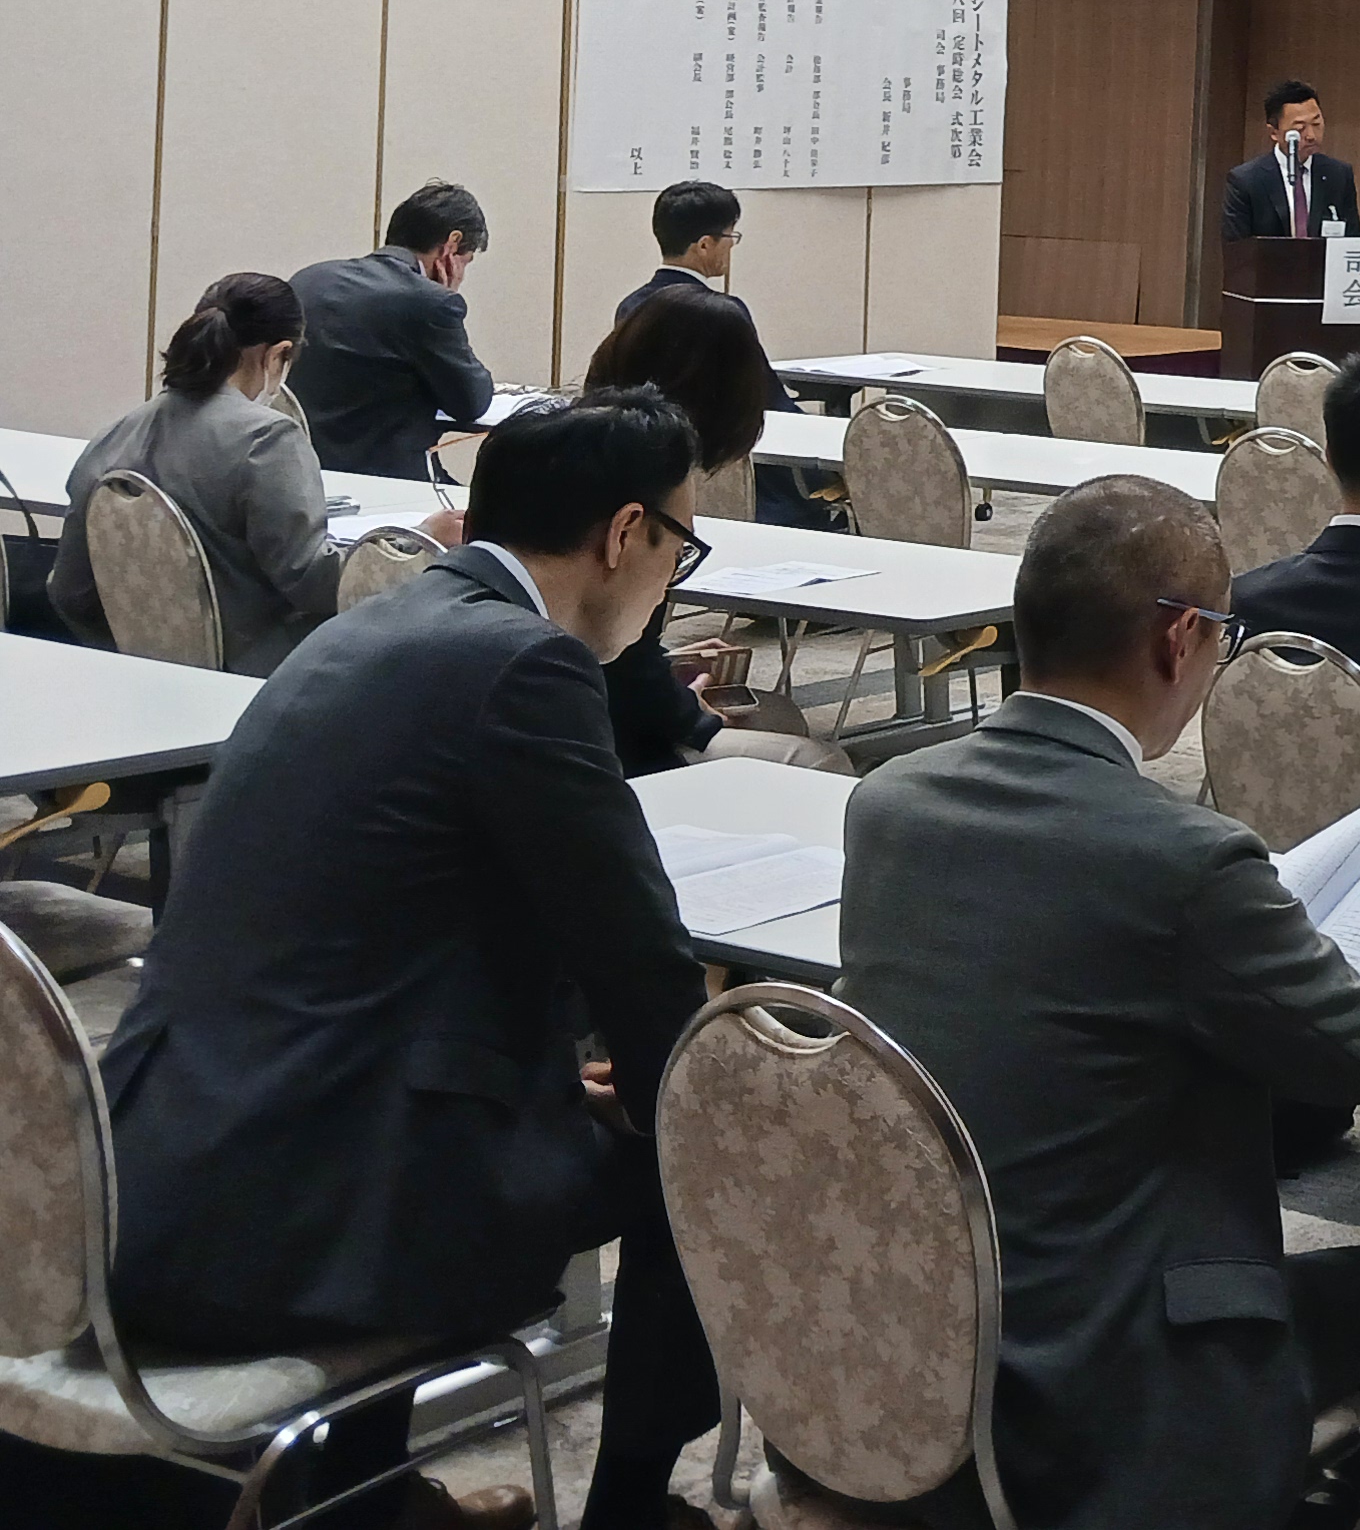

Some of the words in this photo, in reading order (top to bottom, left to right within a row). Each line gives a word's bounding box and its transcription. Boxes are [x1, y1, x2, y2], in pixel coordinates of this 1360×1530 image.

[936, 29, 946, 55] 司会
[935, 65, 946, 104] 事務局
[951, 35, 966, 100] 定時総会
[629, 146, 643, 175] 以上
